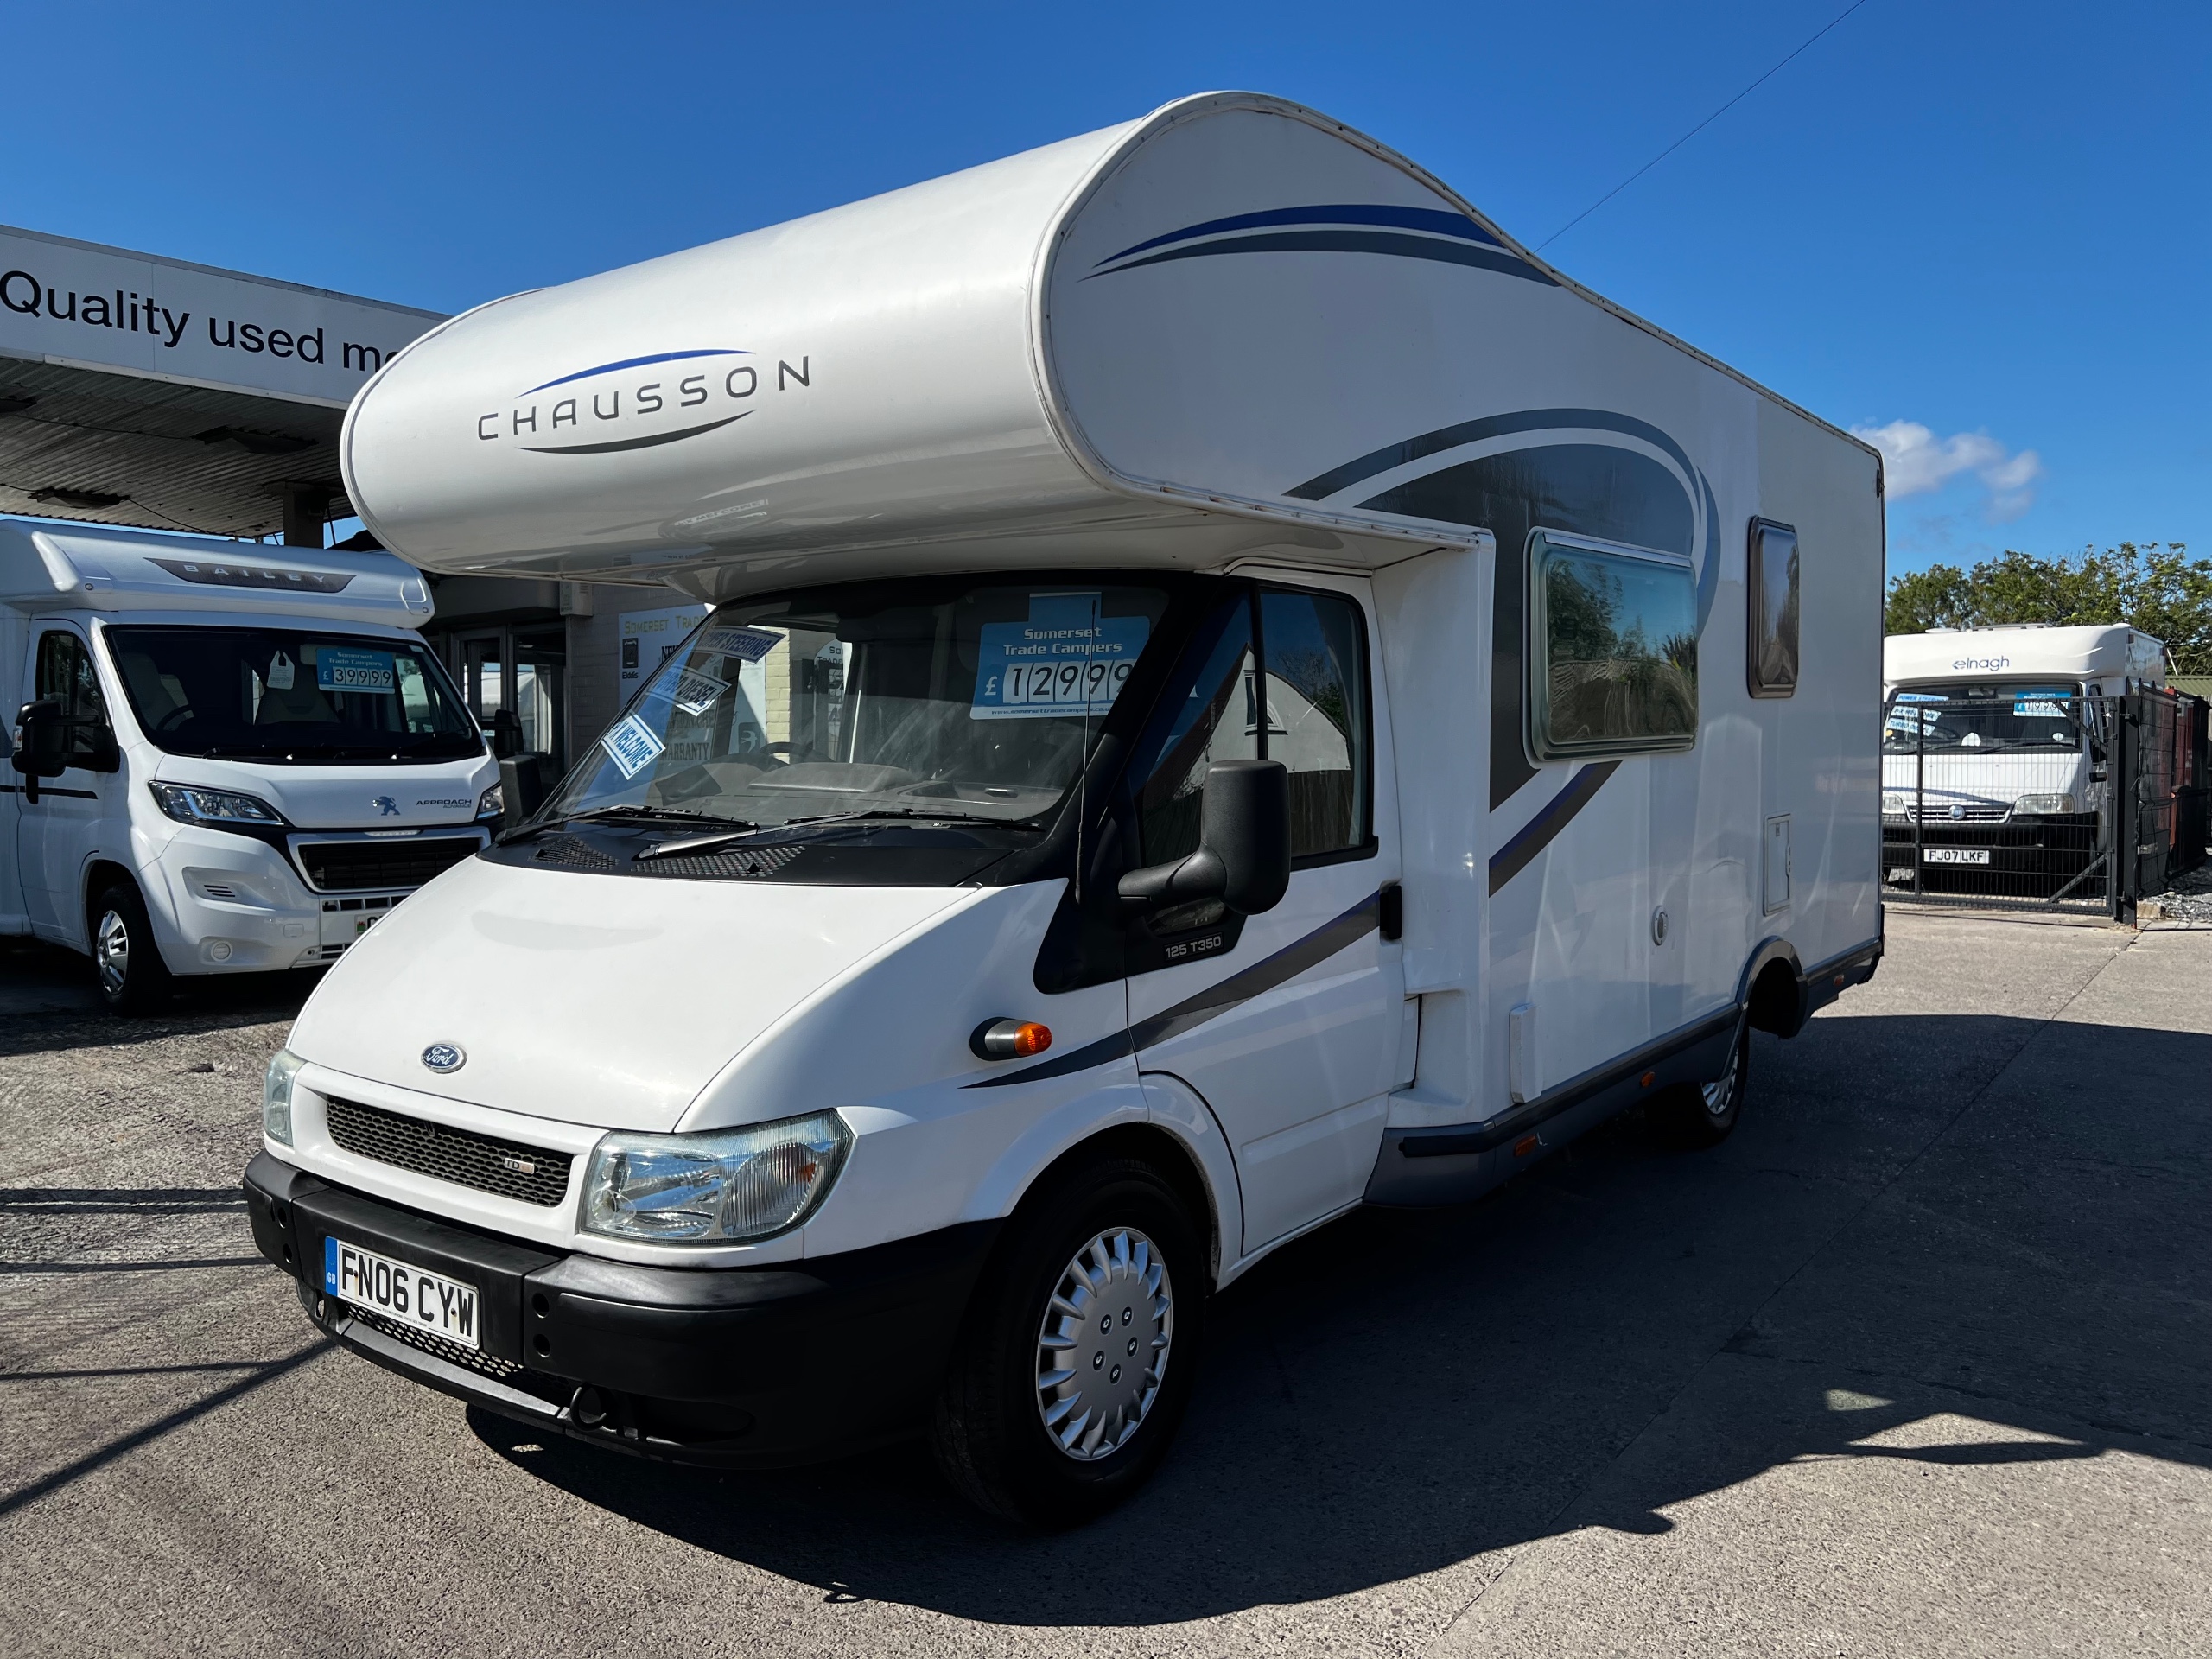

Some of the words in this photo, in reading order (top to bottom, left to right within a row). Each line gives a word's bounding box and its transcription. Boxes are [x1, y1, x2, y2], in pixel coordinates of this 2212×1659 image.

[1, 270, 190, 347] Quality
[209, 317, 324, 364] used
[477, 355, 810, 441] CHAUSSON
[183, 564, 325, 582] BAILEY
[625, 620, 669, 634] SOMERSET
[1024, 626, 1102, 639] Somerset
[722, 633, 772, 656] STEERING
[1003, 644, 1047, 656] Trade
[1052, 642, 1122, 656] Campers
[1952, 655, 2010, 671] elnagh
[323, 671, 329, 680] £
[335, 669, 391, 684] 39999
[622, 671, 639, 680] Elddis
[984, 676, 998, 696] £
[1013, 664, 1134, 696] 12999
[681, 679, 717, 707] DIESEL
[613, 725, 653, 769] WELCOME
[1929, 850, 1959, 861] FJ07
[1961, 851, 1985, 861] LKF
[1166, 944, 1187, 958] 125
[1190, 936, 1222, 952] T350
[426, 1046, 454, 1065] Ford
[327, 1271, 336, 1285] GB
[342, 1248, 409, 1313] FN06
[418, 1276, 474, 1338] CYW
